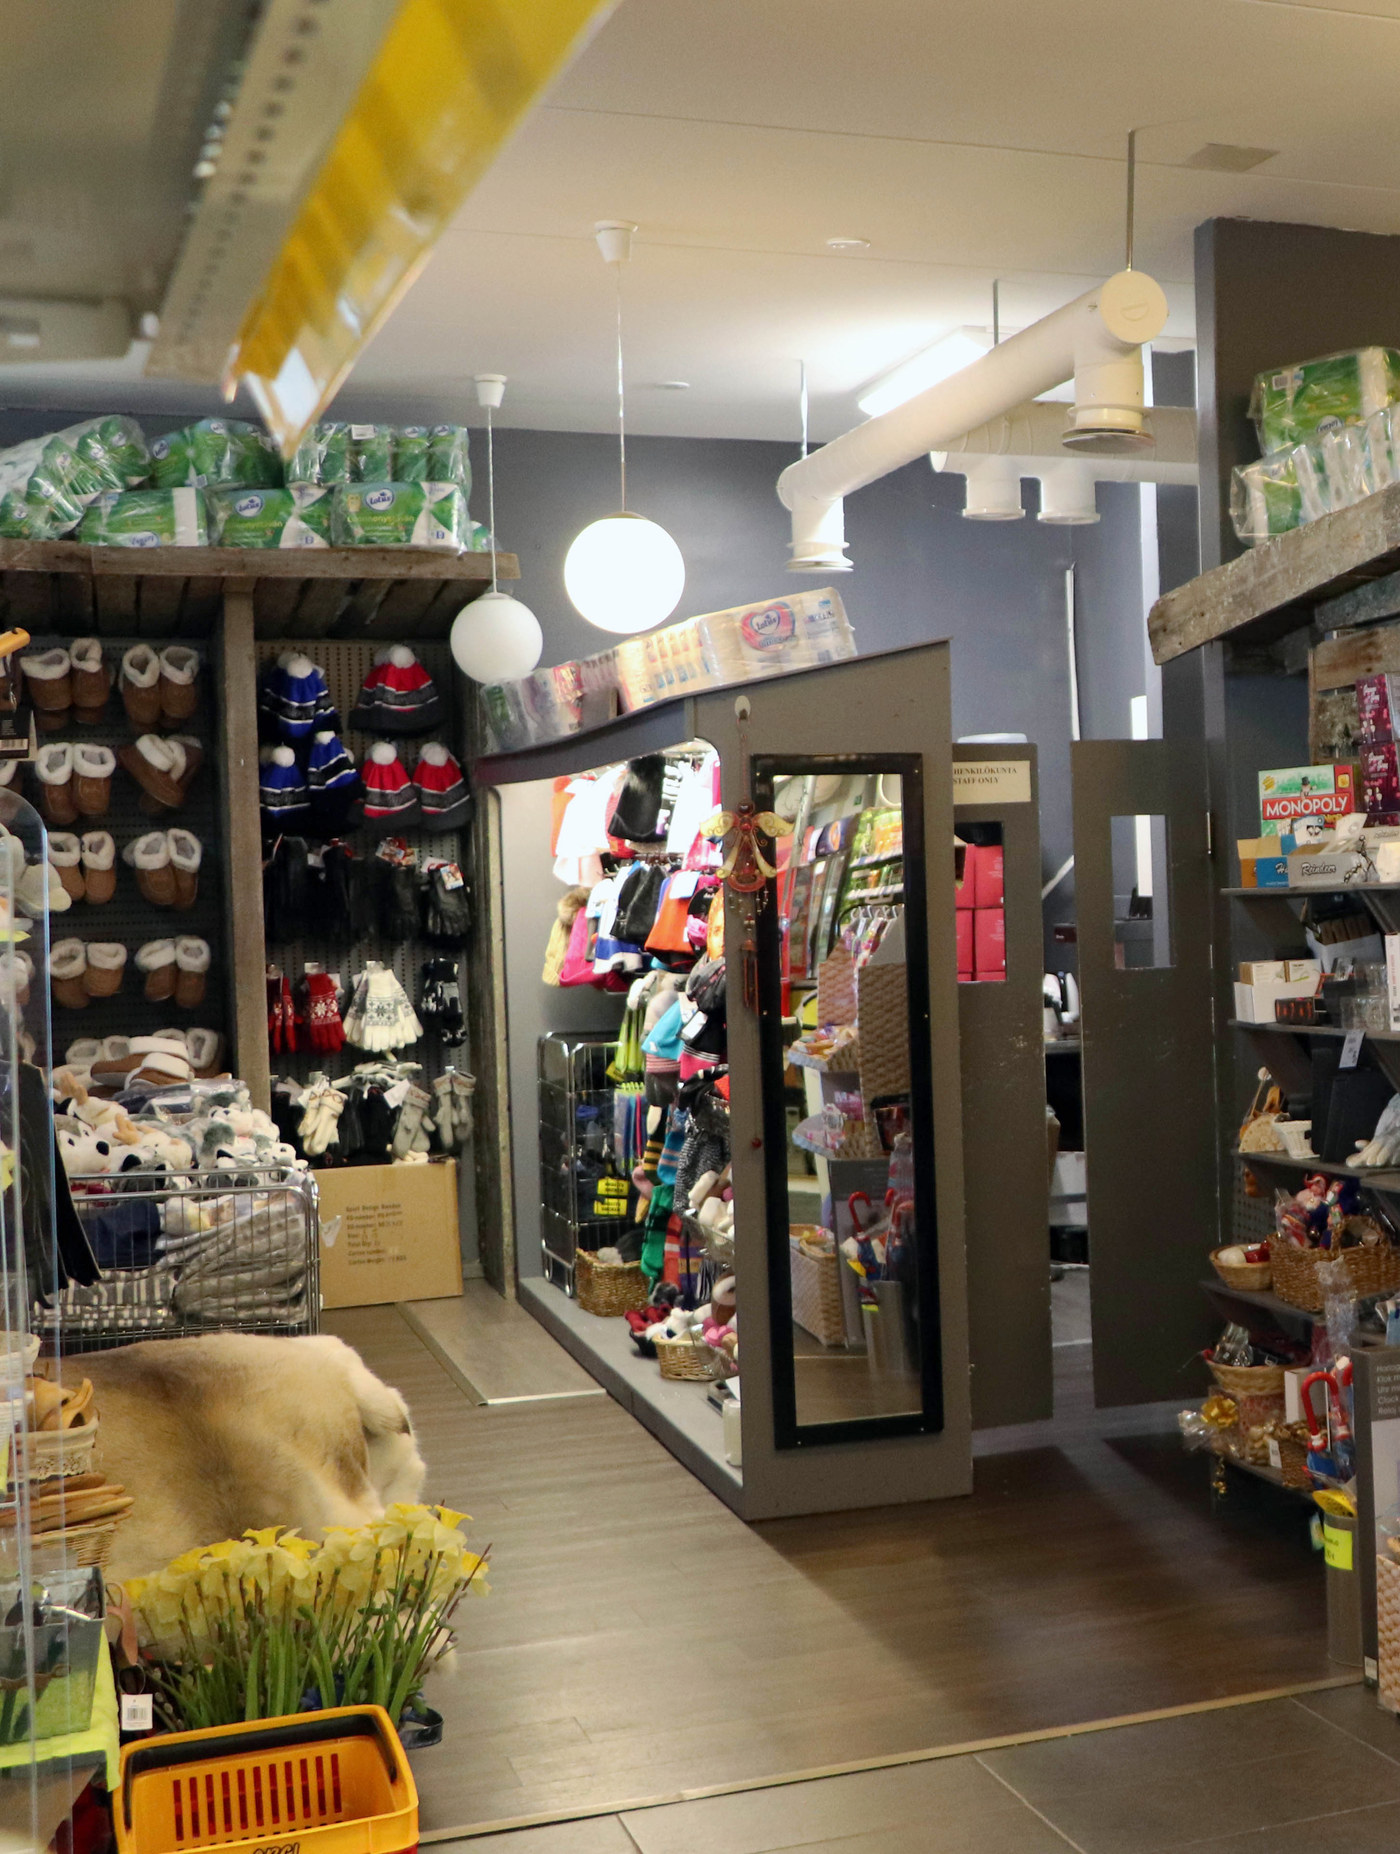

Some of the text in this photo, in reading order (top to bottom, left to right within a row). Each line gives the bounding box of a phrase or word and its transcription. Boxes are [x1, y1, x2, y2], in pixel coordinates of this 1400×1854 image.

[756, 616, 777, 630] Lotus
[953, 765, 1017, 775] HENKILÖKUNTA
[953, 776, 1000, 785] STAFF ONLY
[1266, 795, 1348, 817] MONOPOLY
[1301, 862, 1337, 877] Reindeer
